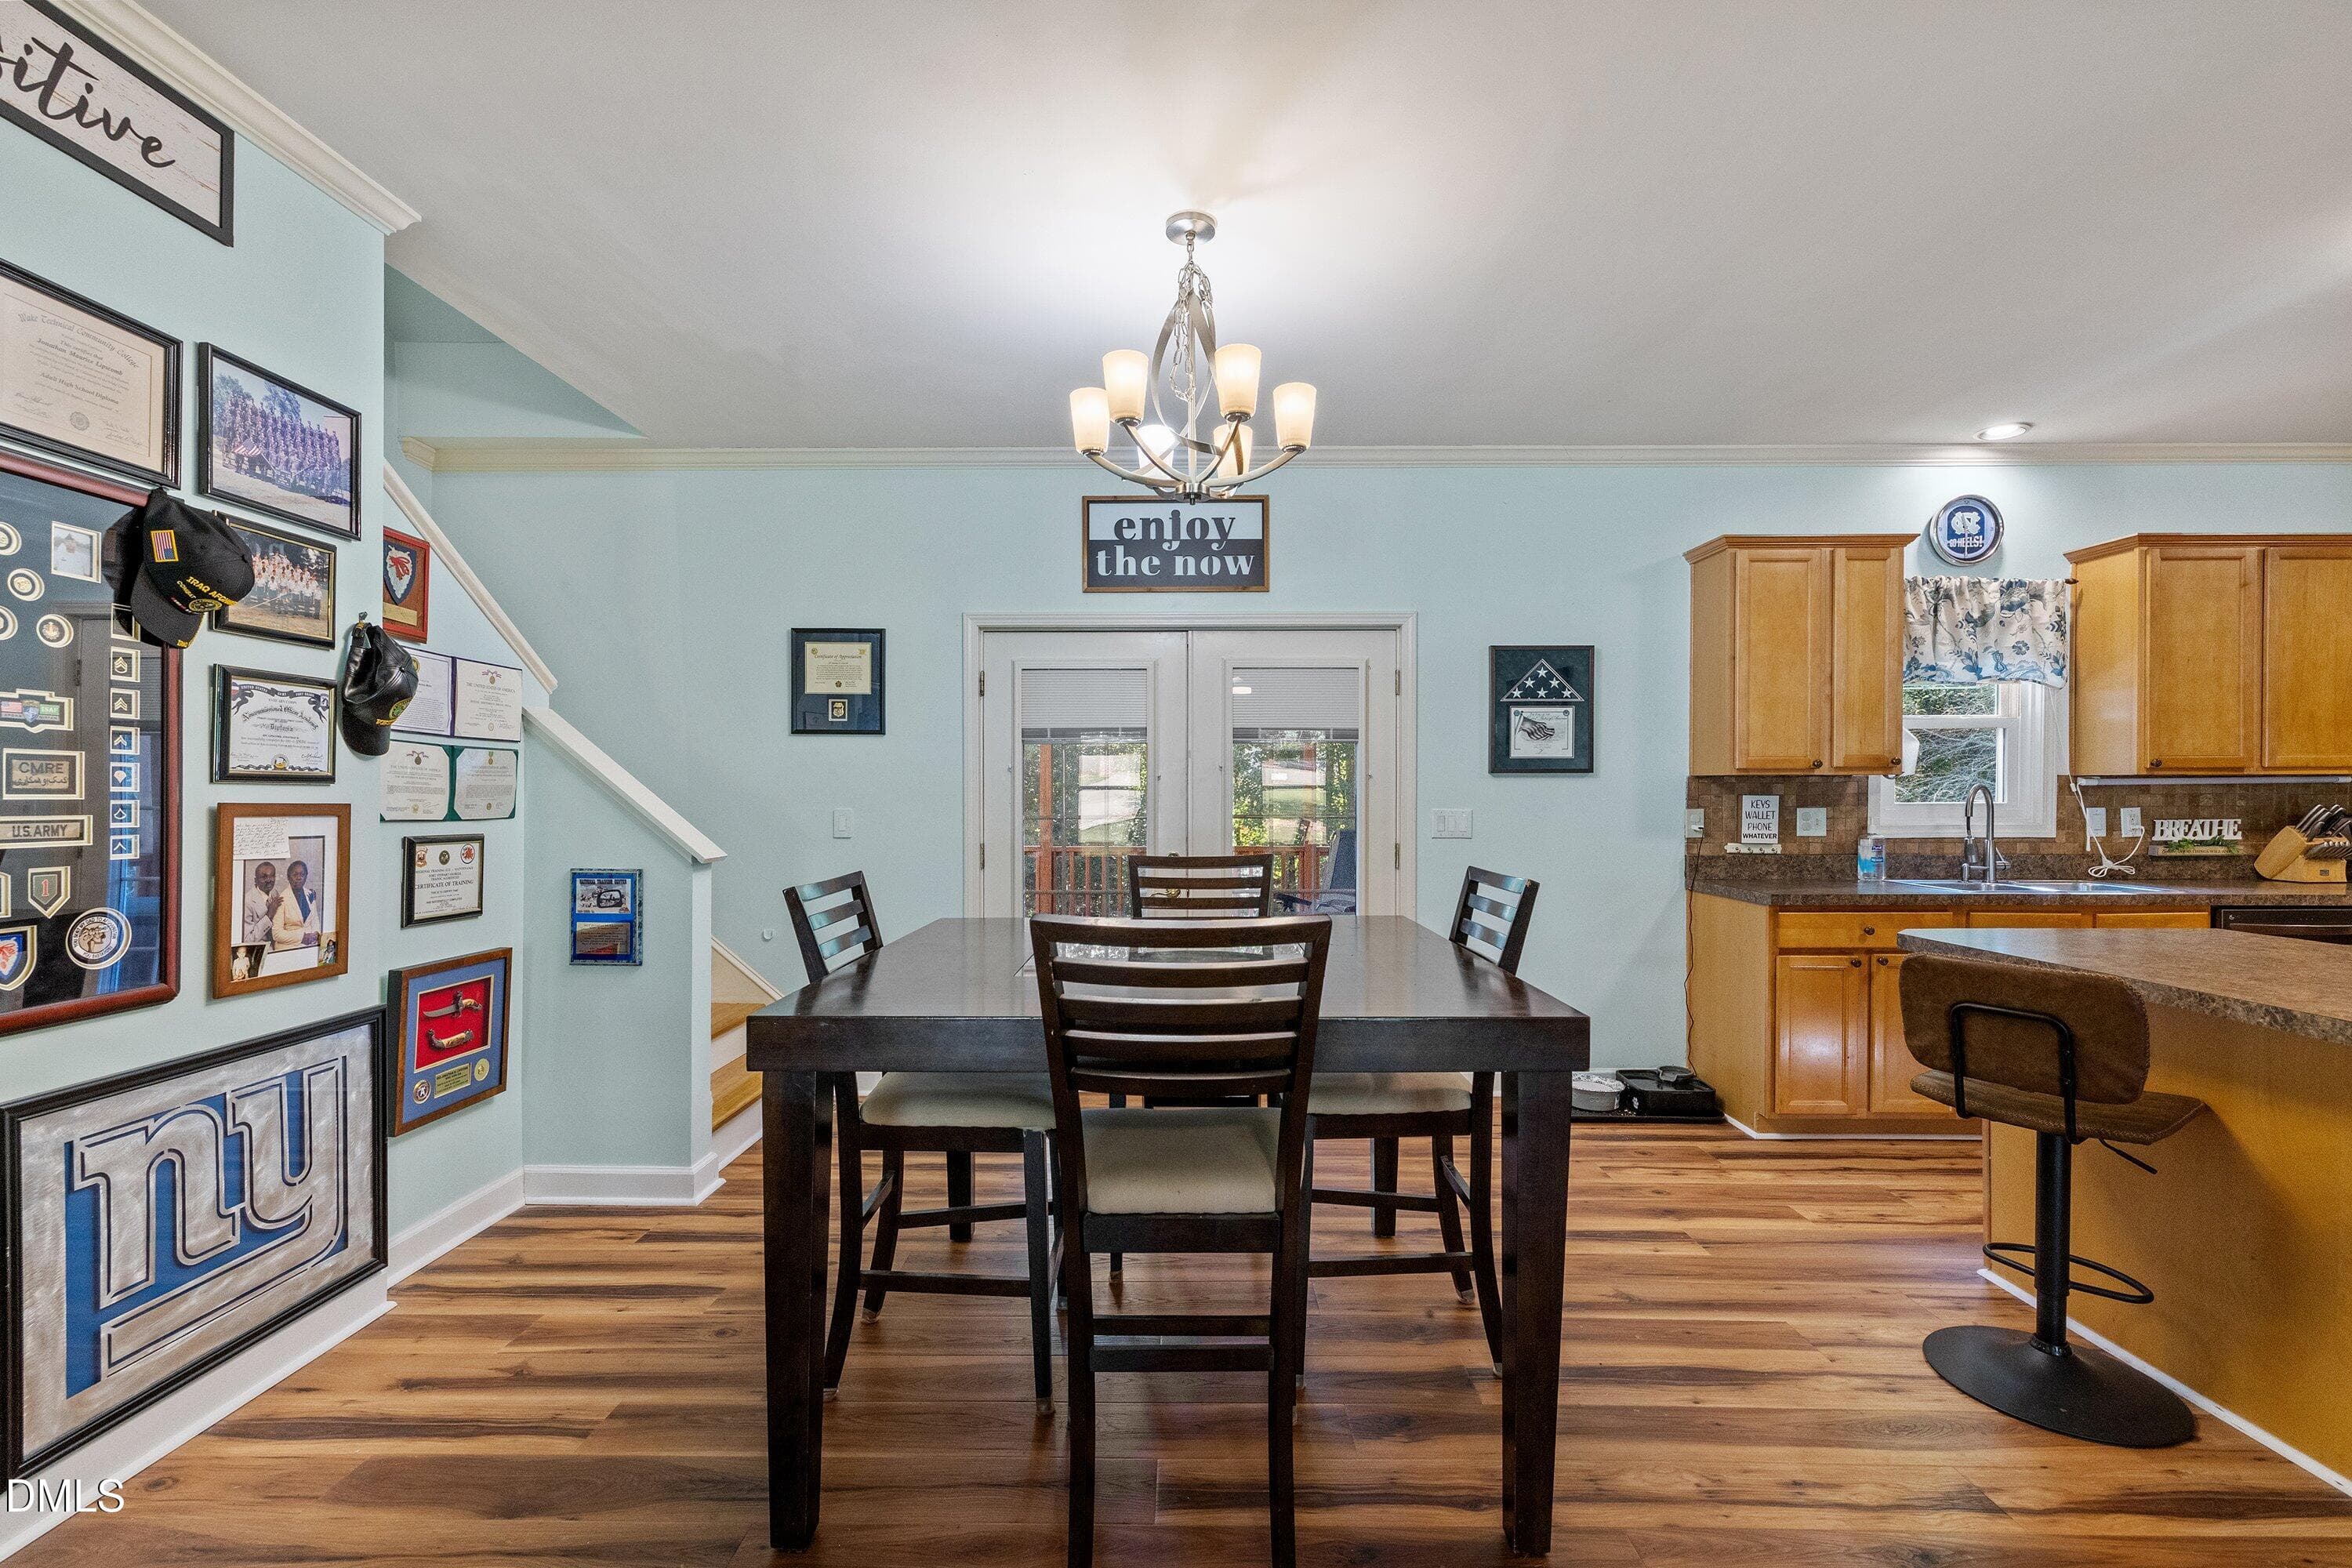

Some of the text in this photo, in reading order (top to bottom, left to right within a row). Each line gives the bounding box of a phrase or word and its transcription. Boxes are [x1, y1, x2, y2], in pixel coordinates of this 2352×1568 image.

[37, 337, 66, 353] Jonathan
[69, 350, 93, 364] Maurice
[96, 361, 123, 376] Lipscomb
[77, 327, 115, 351] Community
[117, 348, 139, 368] College
[75, 384, 94, 396] School
[96, 391, 119, 405] Diploma
[1114, 510, 1236, 550] enjoy
[1097, 545, 1255, 576] the now
[187, 575, 210, 593] IRAQ
[19, 761, 64, 775] CMRE
[1751, 800, 1771, 808] KEYS
[1745, 811, 1775, 819] WALLET
[34, 824, 67, 837] ARMY
[1748, 822, 1773, 831] PHONE
[2151, 819, 2242, 841] BREATHE
[41, 879, 49, 897] 1
